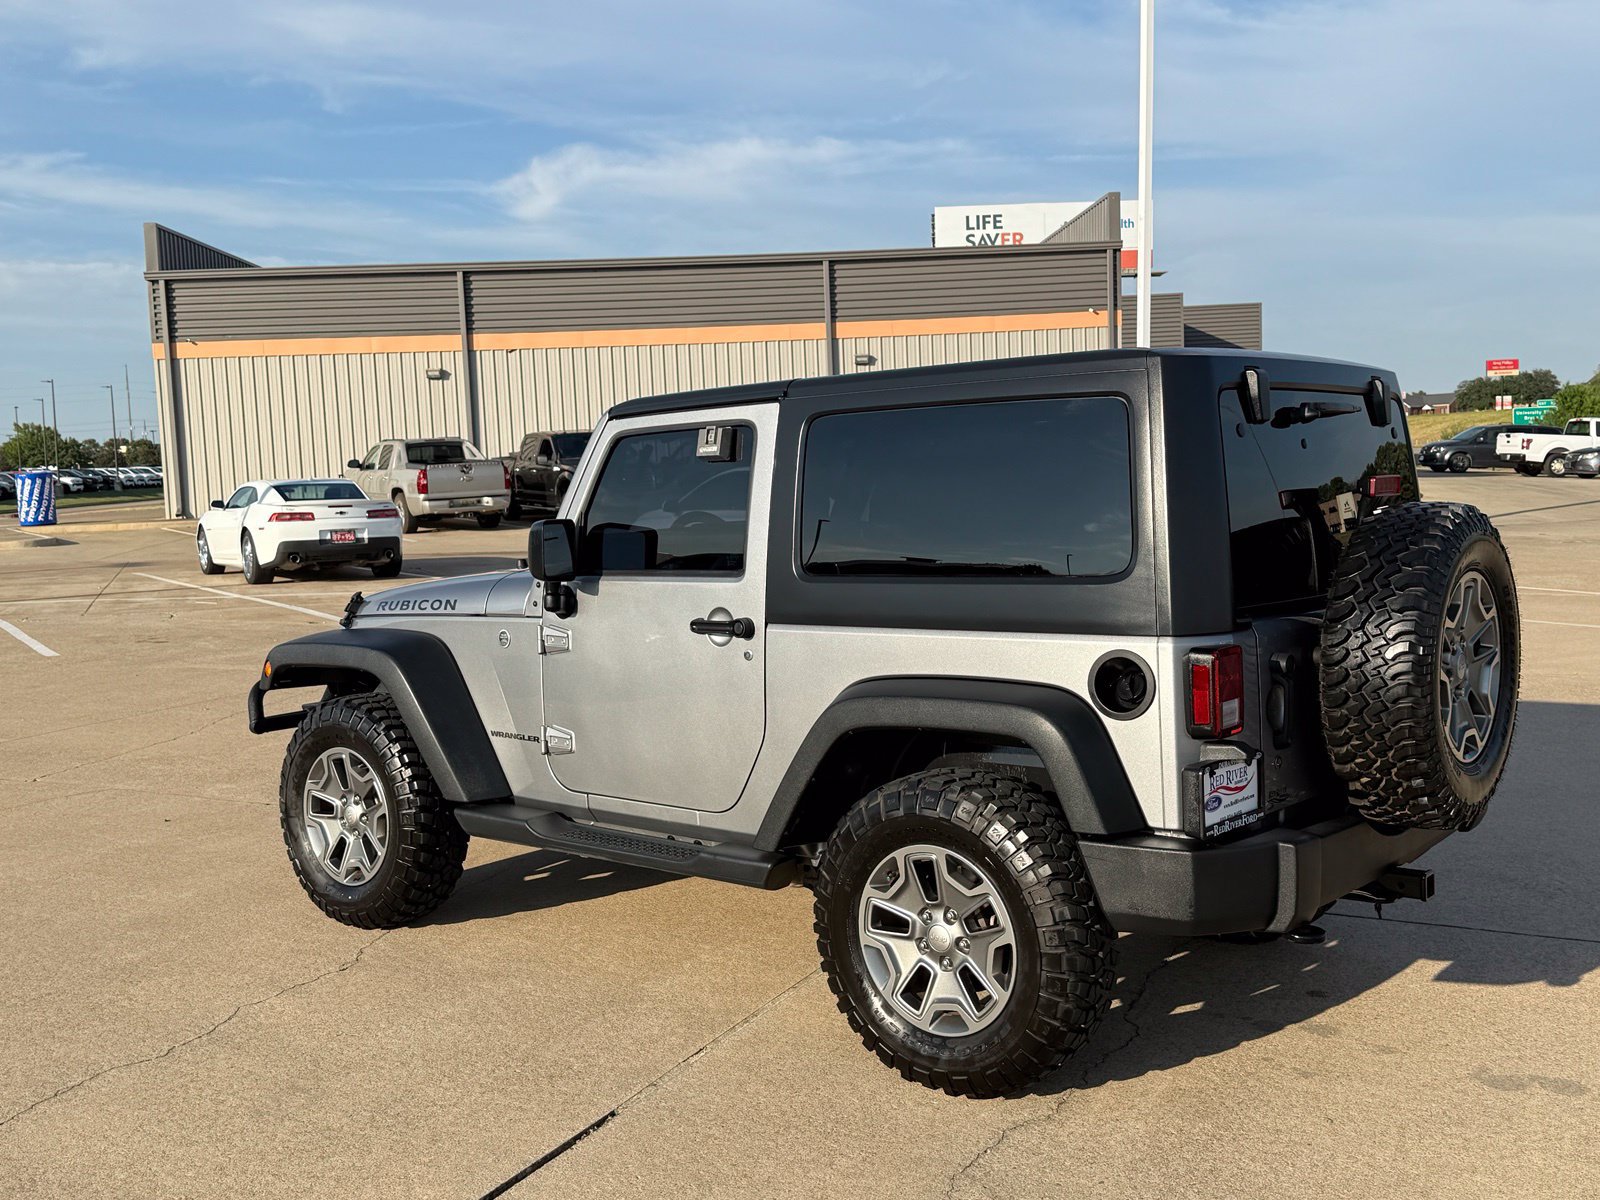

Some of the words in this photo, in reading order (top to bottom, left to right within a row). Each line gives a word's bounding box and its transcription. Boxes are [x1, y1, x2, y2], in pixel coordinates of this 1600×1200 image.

[965, 214, 1003, 230] LIFE
[965, 232, 1024, 246] SAVER
[376, 599, 458, 611] RUBICON
[490, 730, 541, 743] WRANGLER
[1209, 774, 1225, 791] RED
[1225, 765, 1248, 785] RIVER
[1207, 798, 1219, 810] Ford
[930, 933, 947, 943] Jeep
